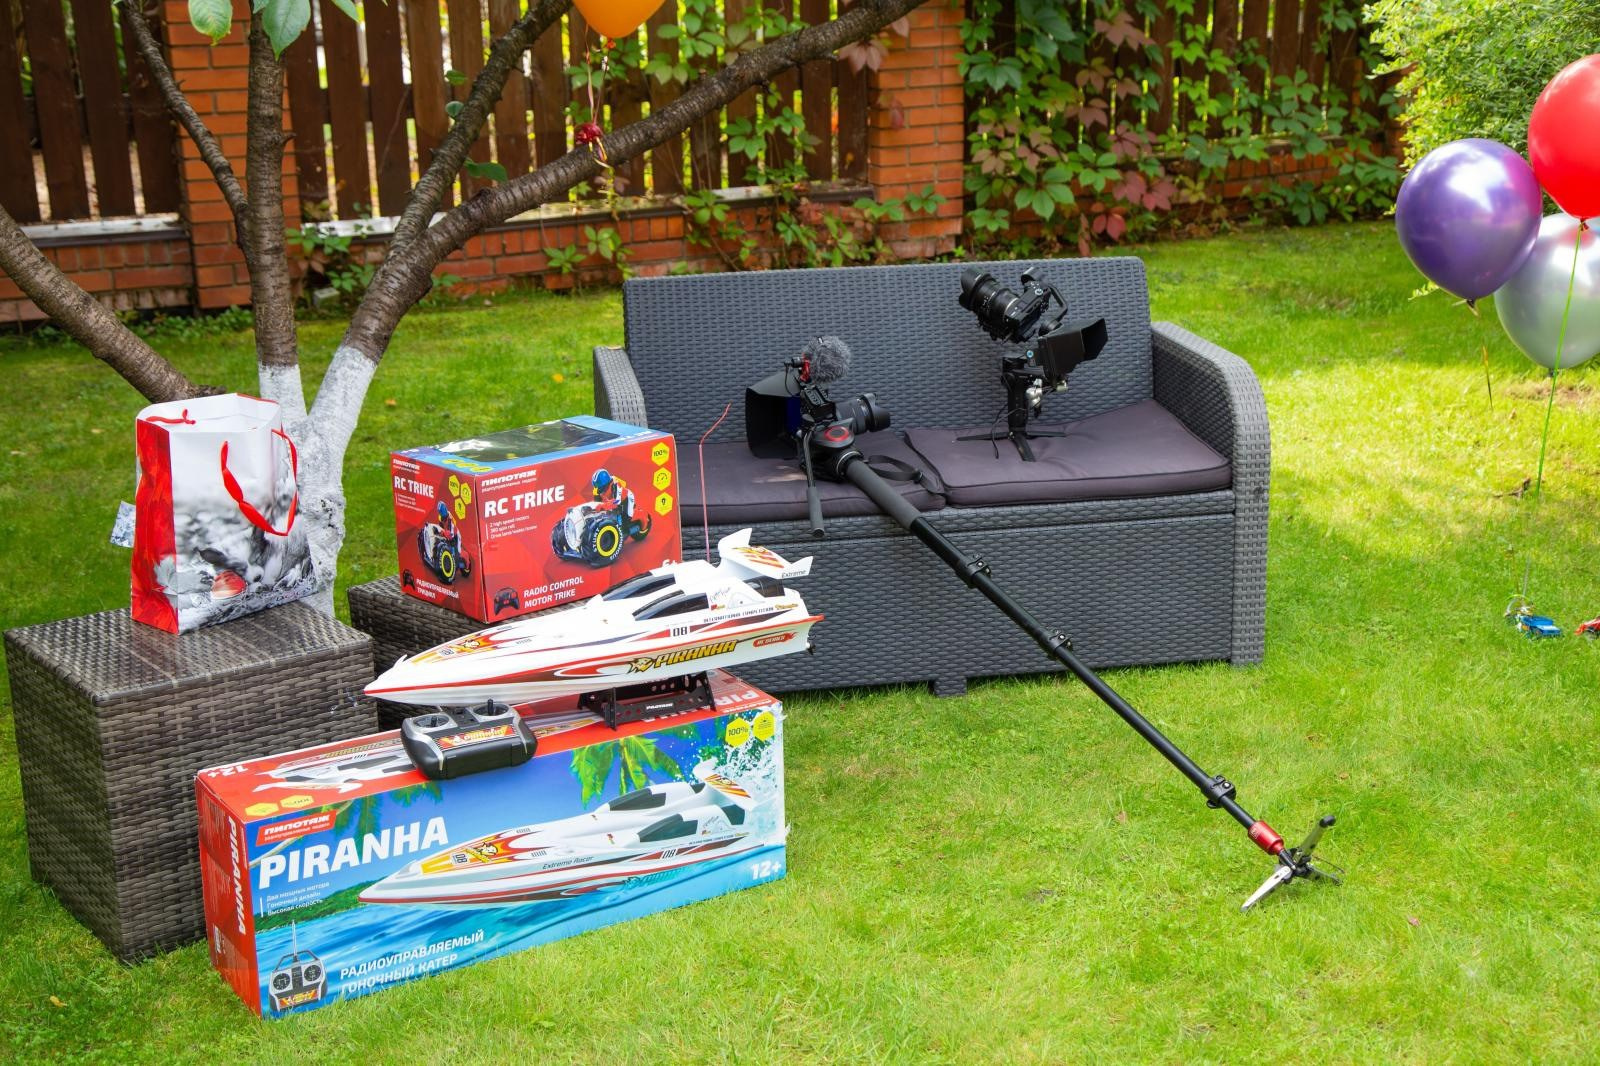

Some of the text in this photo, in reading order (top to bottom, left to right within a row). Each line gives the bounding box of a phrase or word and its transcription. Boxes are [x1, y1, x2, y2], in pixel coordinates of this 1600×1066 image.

[394, 476, 434, 499] RC TRIKE
[484, 485, 565, 518] RC TRIKE
[523, 575, 584, 598] RADIO CONTROL
[524, 588, 576, 608] MOTOR TRIKE
[672, 626, 688, 637] 08
[653, 639, 738, 669] PIRANHA
[728, 726, 748, 736] 100%
[258, 816, 449, 890] PIRANHA
[662, 848, 677, 859] 08
[228, 815, 246, 936] PIRANHA
[751, 859, 782, 880] 12+
[340, 928, 485, 980] РАДИОУПРАВЛЯЕМЫЙ
[341, 952, 458, 995] ГОНОЧНЫЙ КАТЕР
